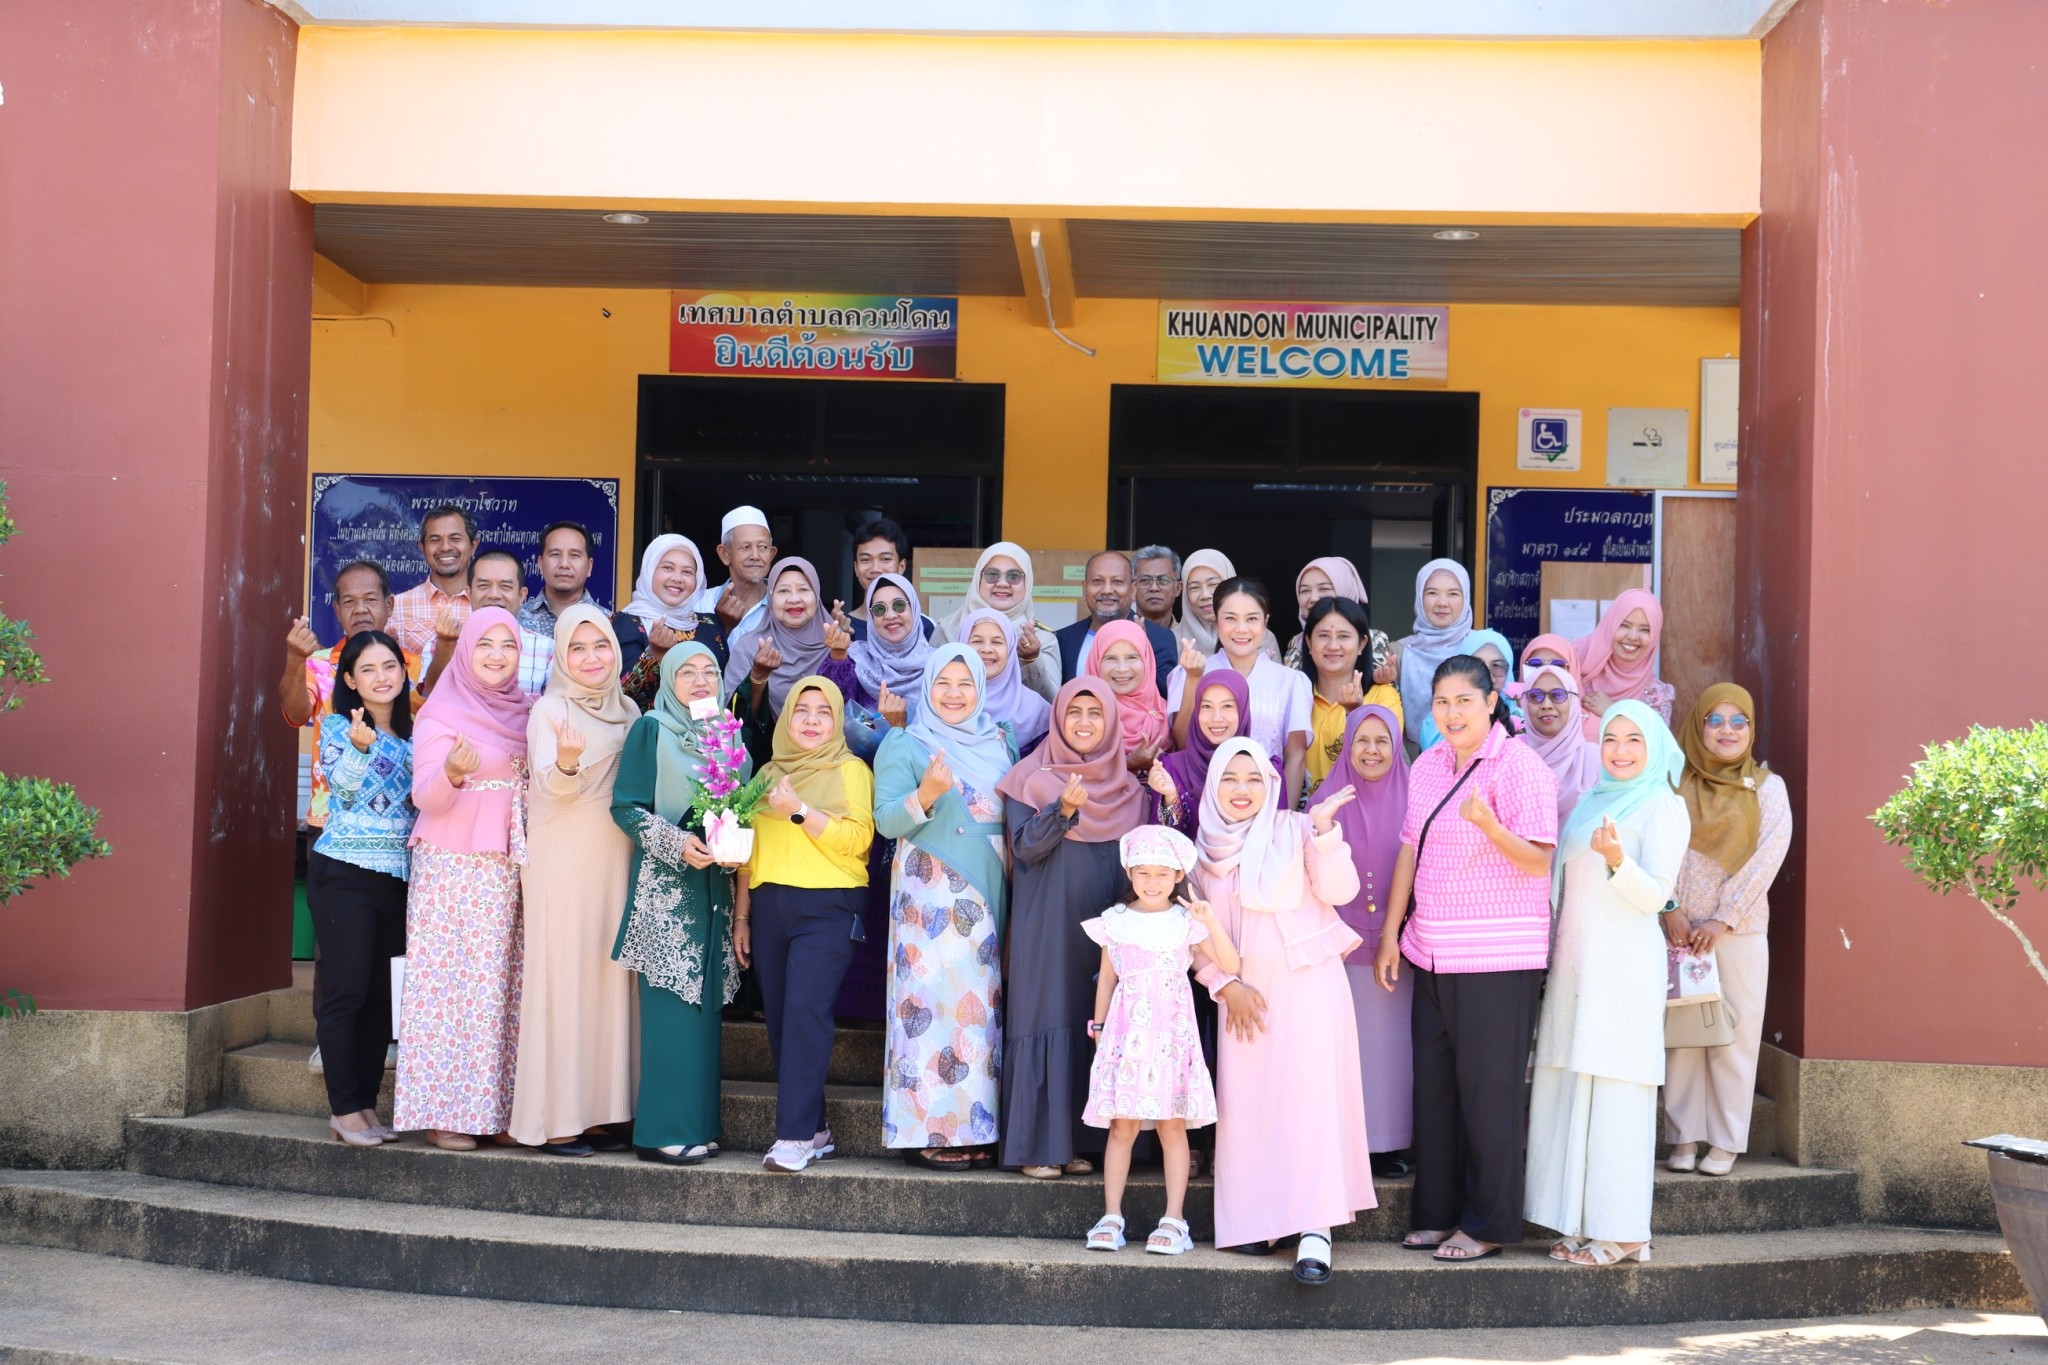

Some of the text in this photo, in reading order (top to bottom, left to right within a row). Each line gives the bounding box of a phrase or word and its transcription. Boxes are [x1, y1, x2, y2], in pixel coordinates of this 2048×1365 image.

[679, 299, 949, 330] เทศบาลตำบลควนโดน
[1168, 311, 1438, 341] KHUANDON MUNICIPALITY
[715, 332, 914, 371] ยินดีต้อนรับ
[1197, 344, 1410, 378] WELCOME
[1522, 543, 1558, 558] มาตรา
